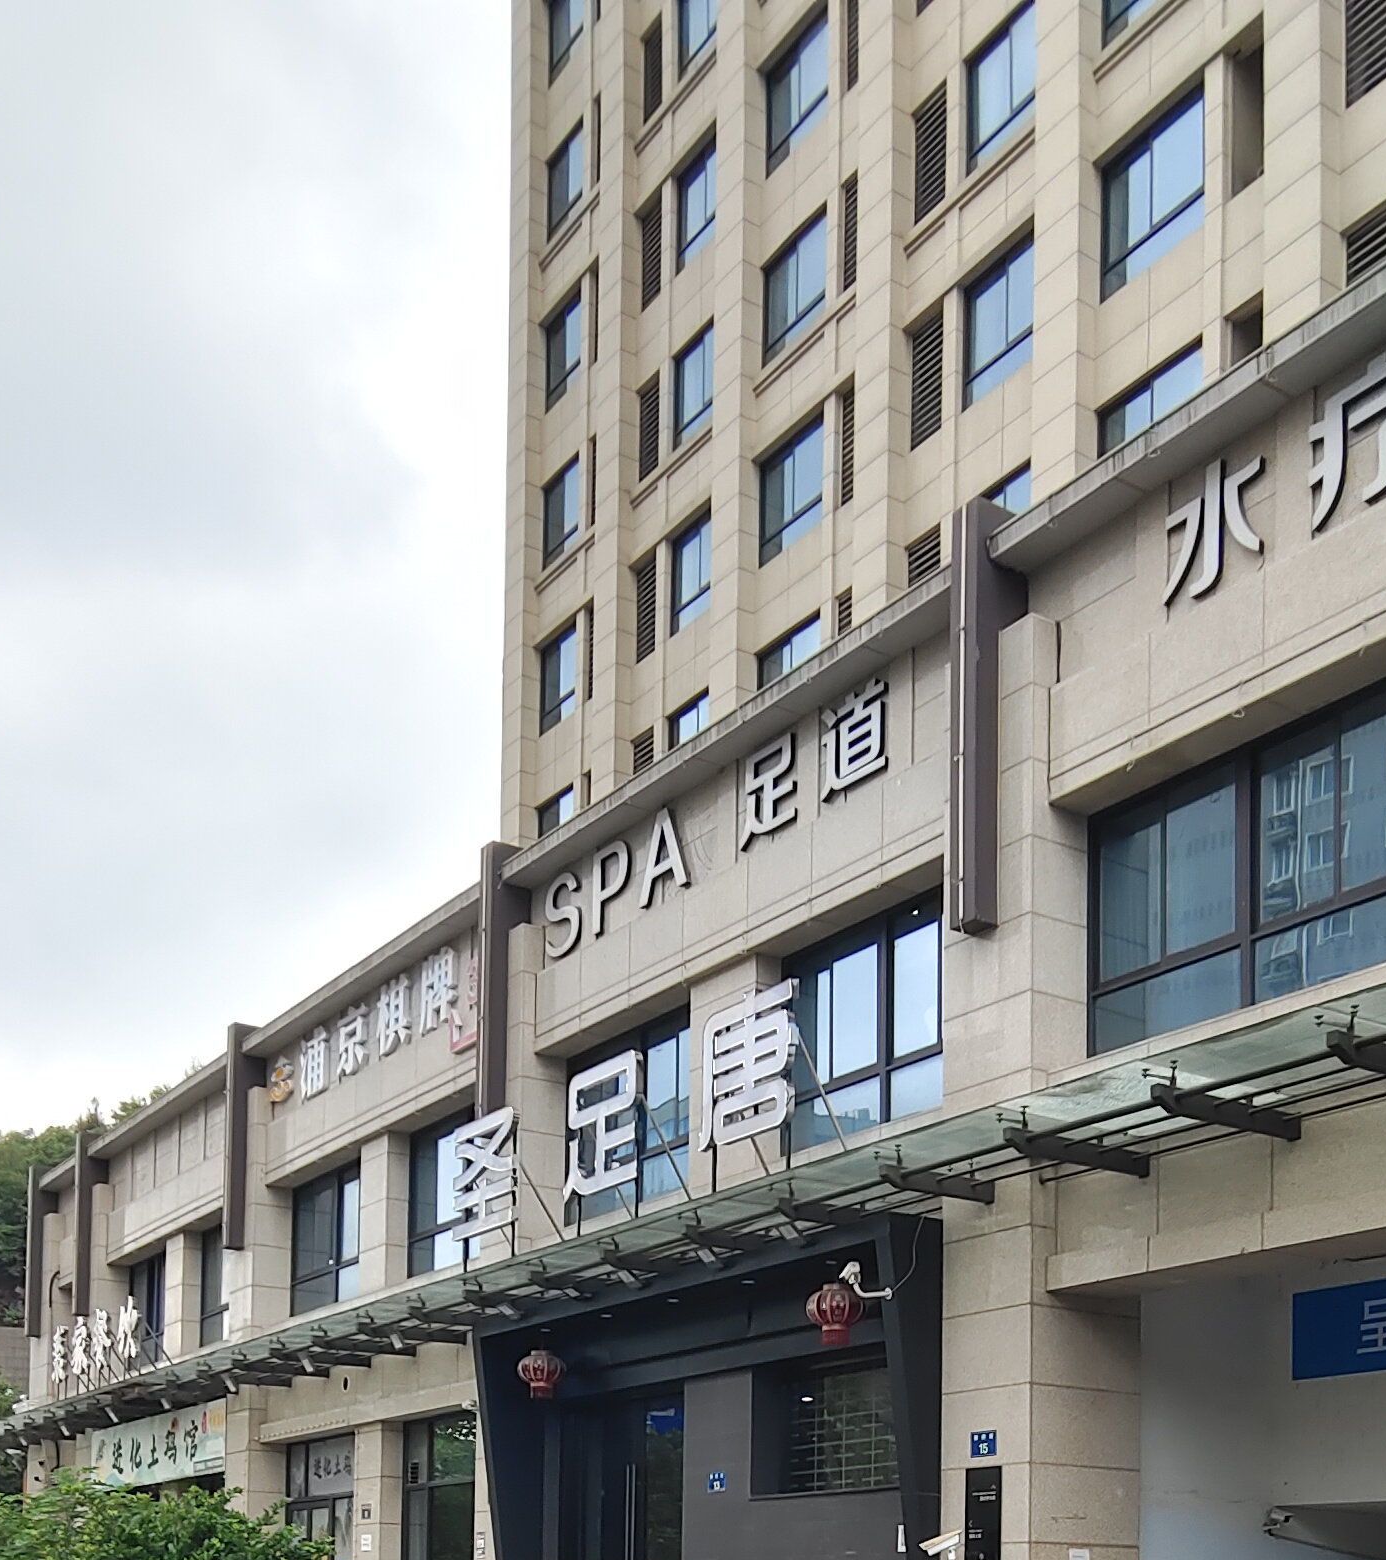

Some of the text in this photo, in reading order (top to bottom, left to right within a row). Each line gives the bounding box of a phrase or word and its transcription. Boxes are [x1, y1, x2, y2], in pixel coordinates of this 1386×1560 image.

[545, 678, 888, 958] SPA 足道
[300, 946, 459, 1103] 浦京棋牌
[451, 978, 801, 1242] 圣足唐
[978, 1442, 989, 1455] 15
